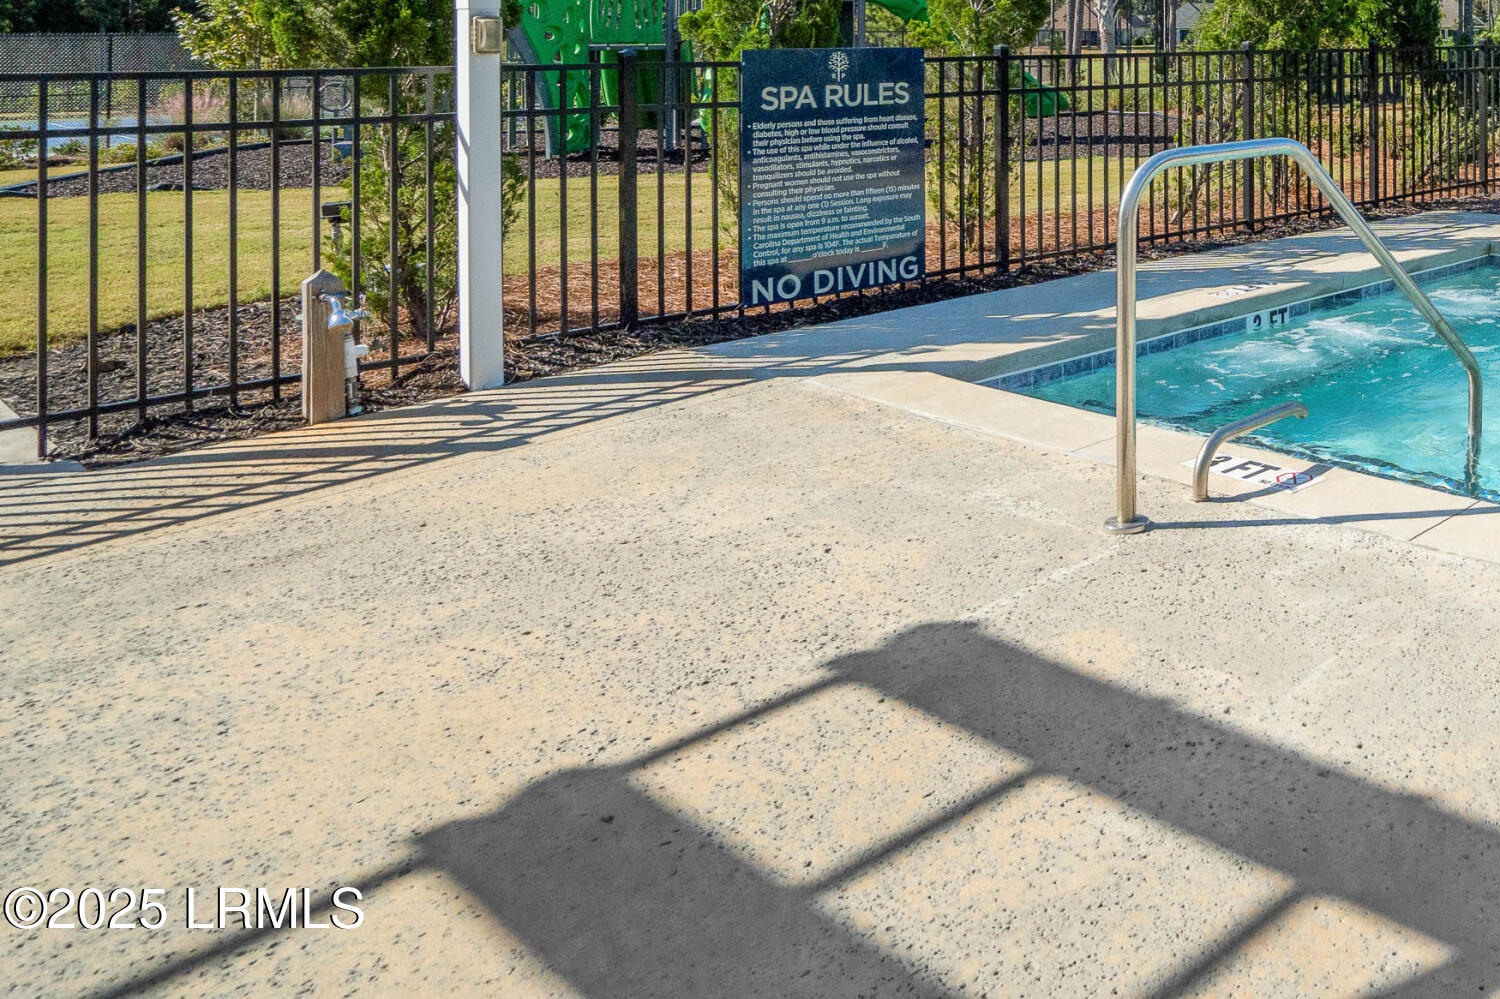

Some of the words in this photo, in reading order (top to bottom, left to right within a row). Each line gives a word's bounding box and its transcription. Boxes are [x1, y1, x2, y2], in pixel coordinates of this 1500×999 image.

[761, 86, 817, 110] SPA
[826, 82, 910, 108] RULES
[752, 121, 775, 130] Elderly
[777, 121, 802, 129] persons
[752, 129, 782, 138] diabetes,
[784, 128, 798, 137] high
[841, 125, 865, 133] pressure
[752, 147, 764, 155] The
[831, 141, 849, 149] under
[770, 137, 800, 146] physician
[801, 135, 822, 143] before
[823, 134, 840, 142] using
[795, 159, 829, 169] stimulants,
[862, 154, 889, 162] narcotics
[753, 170, 793, 182] tranquilizers
[753, 180, 782, 190] Pregnant
[809, 175, 830, 183] should
[878, 169, 899, 177] without
[753, 188, 786, 199] consulting
[788, 186, 803, 194] their
[753, 197, 778, 206] Persons
[780, 195, 801, 203] should
[803, 193, 822, 202] spend
[850, 188, 863, 196] than
[865, 186, 884, 194] fifteen
[885, 185, 896, 193] (15)
[897, 183, 919, 191] minutes
[761, 206, 771, 214] the
[773, 206, 784, 214] spa
[856, 196, 870, 205] Long
[900, 192, 912, 200] may
[753, 215, 771, 223] result
[753, 224, 765, 232] The
[787, 221, 803, 229] open
[753, 232, 765, 240] The
[801, 224, 839, 236] temperature
[885, 217, 892, 225] by
[904, 214, 920, 222] South
[753, 239, 780, 249] Carolina
[782, 234, 820, 246] Department
[829, 230, 849, 239] Health
[753, 248, 779, 258] Control,
[781, 246, 790, 254] for
[792, 246, 803, 254] any
[805, 244, 816, 252] spa
[855, 235, 873, 244] actual
[753, 258, 765, 266] this
[767, 257, 778, 265] spa
[835, 246, 852, 256] today
[752, 275, 801, 304] NO
[814, 256, 918, 294] DIVING
[1221, 460, 1282, 480] FT
